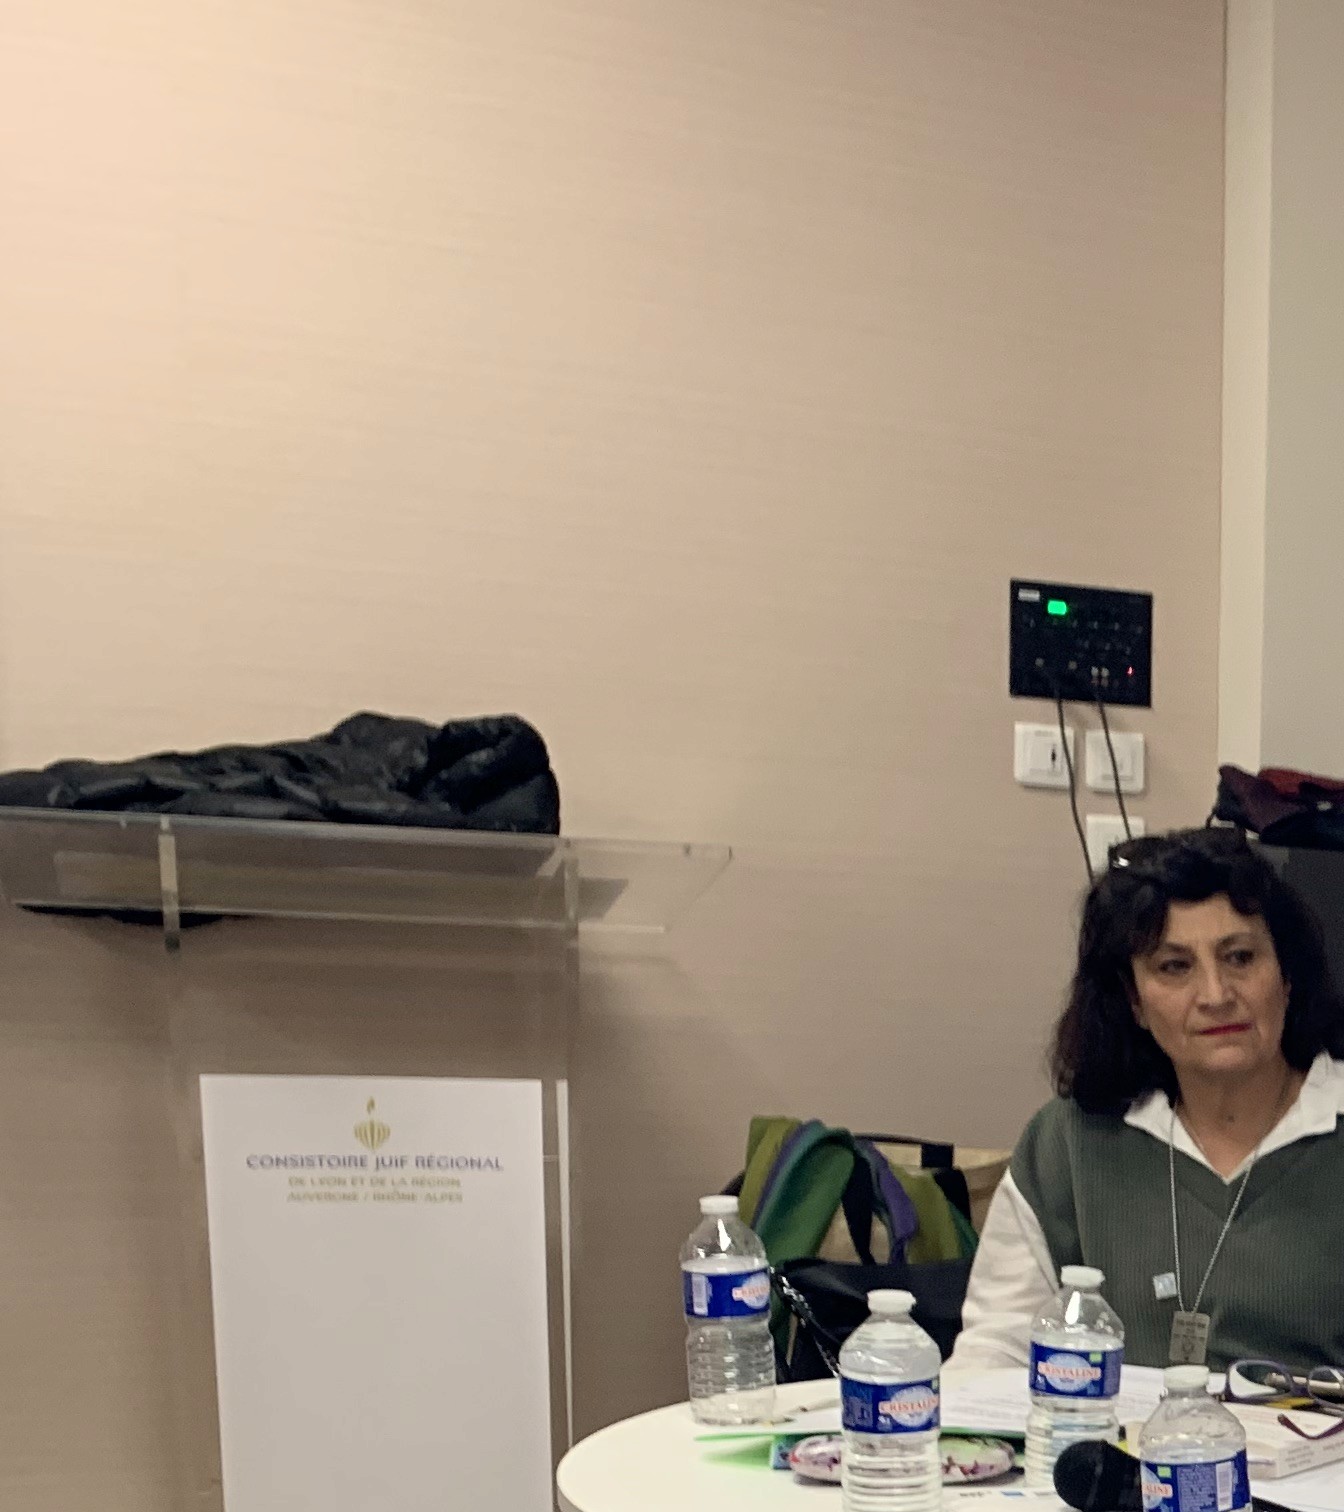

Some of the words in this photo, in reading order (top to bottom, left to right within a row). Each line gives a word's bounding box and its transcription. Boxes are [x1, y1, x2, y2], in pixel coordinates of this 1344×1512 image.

[246, 1154, 368, 1169] CONSISTOIRE
[375, 1154, 407, 1171] JUIF
[415, 1153, 503, 1171] RÉGIONAL
